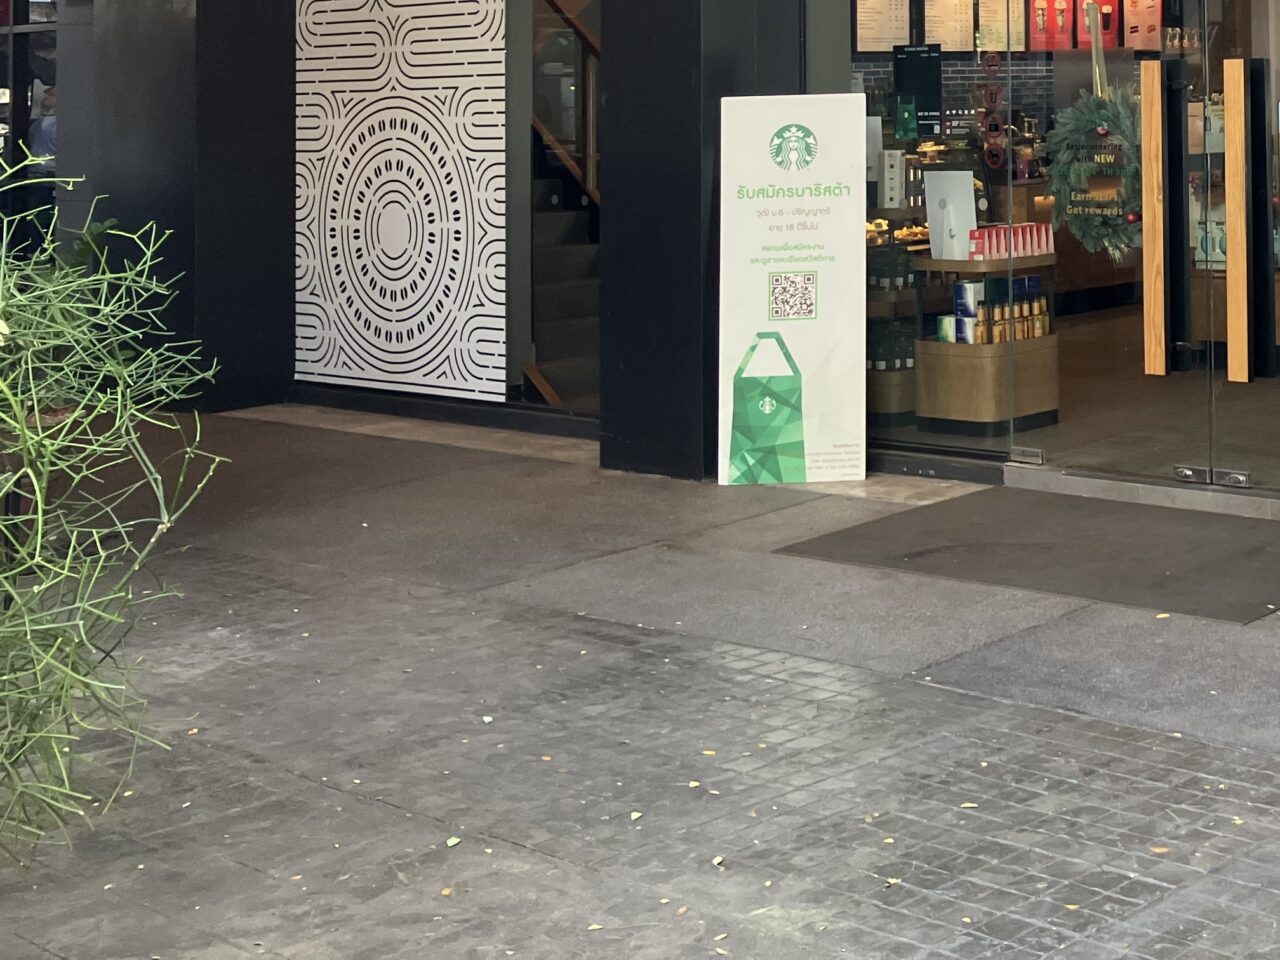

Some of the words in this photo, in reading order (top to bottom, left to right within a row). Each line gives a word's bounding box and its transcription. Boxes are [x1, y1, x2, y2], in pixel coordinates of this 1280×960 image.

[1094, 153, 1115, 164] NEW
[737, 181, 851, 200] รับสมัครบาริสต้า
[1071, 191, 1092, 201] Earn
[1066, 205, 1083, 214] Get
[1085, 206, 1124, 216] rewards
